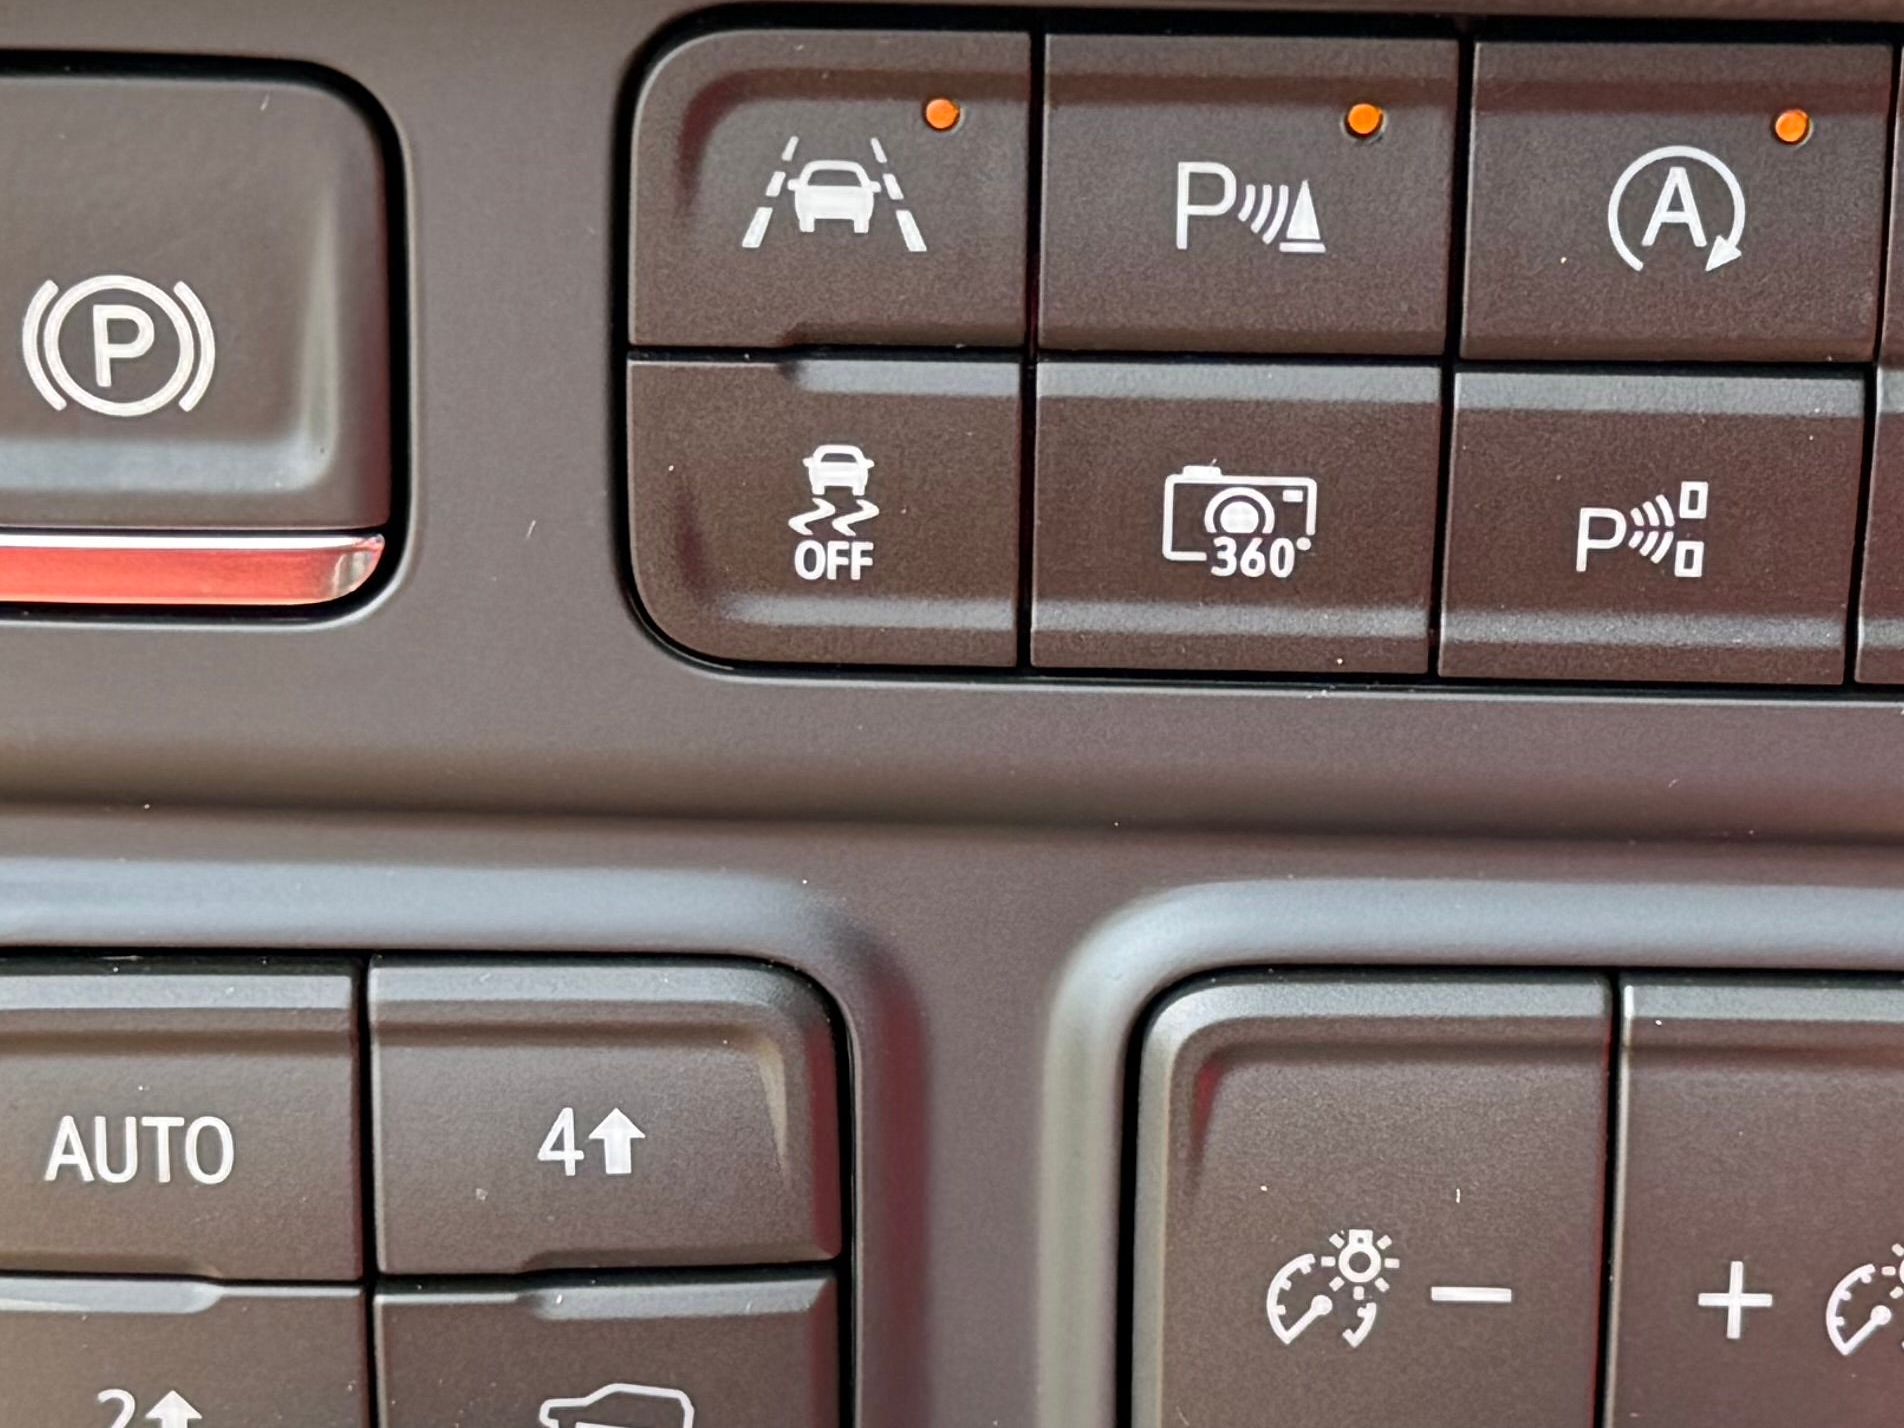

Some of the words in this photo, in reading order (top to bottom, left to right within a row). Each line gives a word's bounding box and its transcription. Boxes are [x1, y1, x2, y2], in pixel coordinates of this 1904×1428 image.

[1175, 160, 1237, 251] P
[1641, 167, 1708, 248] A
[91, 303, 155, 388] P
[793, 538, 875, 582] OFF
[1574, 506, 1627, 573] P
[43, 1114, 235, 1186] AUTO
[536, 1106, 586, 1178] 4
